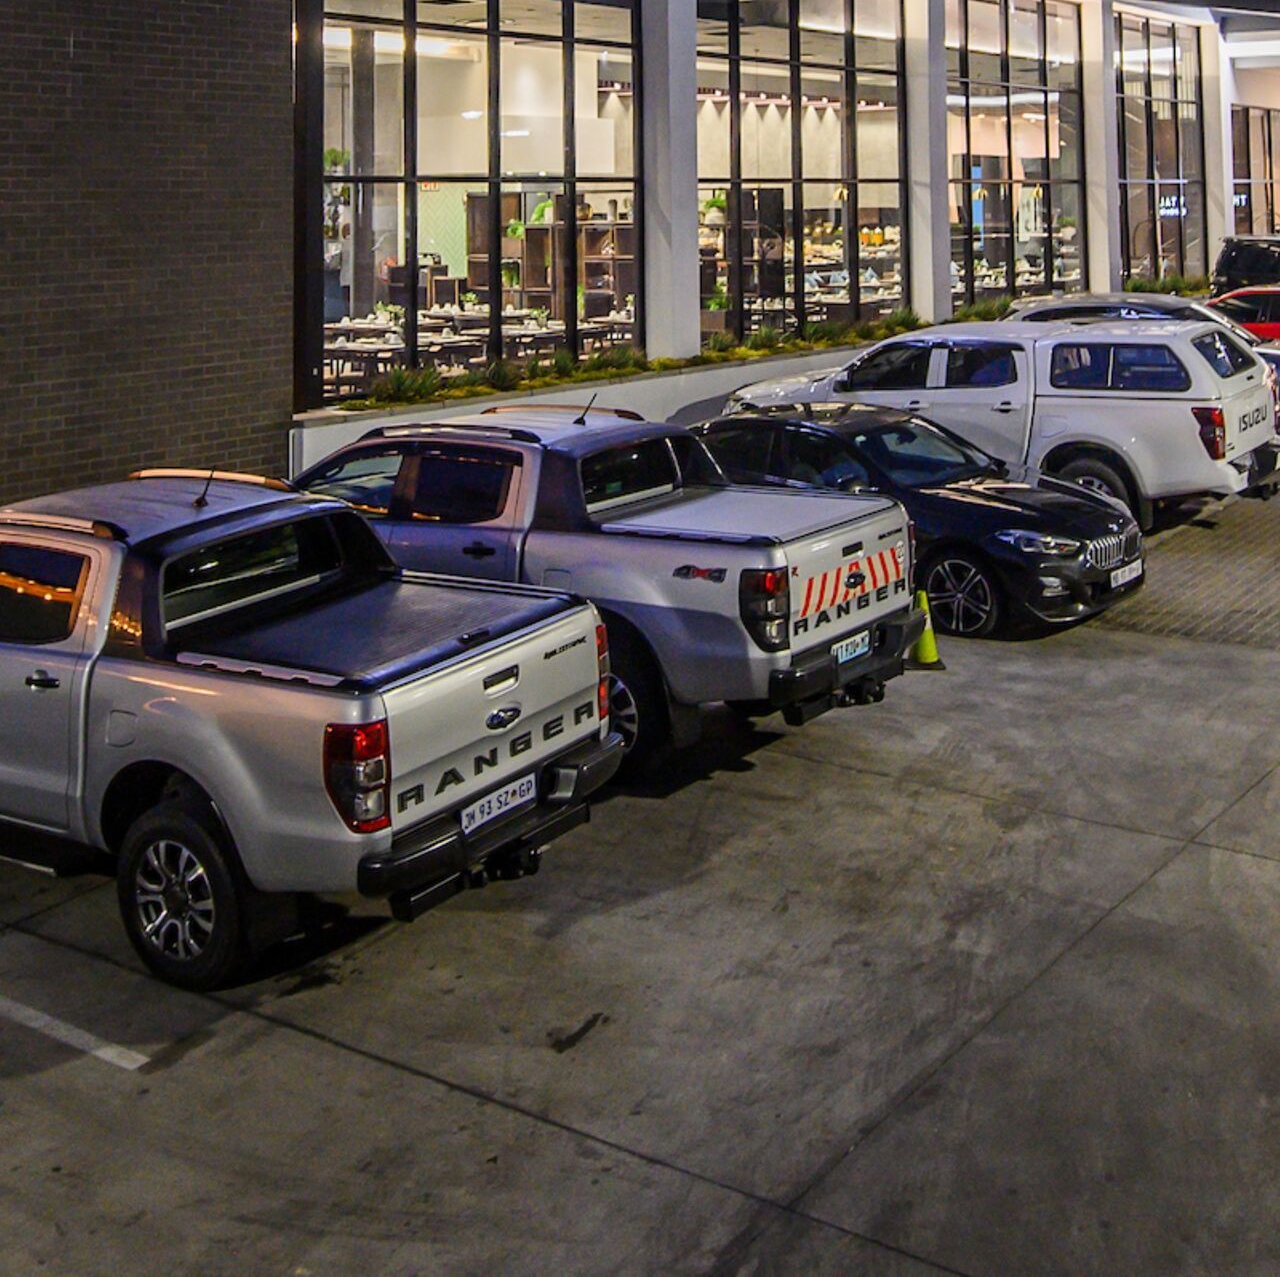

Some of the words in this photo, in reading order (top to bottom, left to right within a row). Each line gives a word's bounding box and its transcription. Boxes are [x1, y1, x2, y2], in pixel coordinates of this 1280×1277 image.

[1239, 404, 1268, 433] ISUZU
[794, 578, 906, 637] RANGER
[397, 700, 594, 814] RANGER
